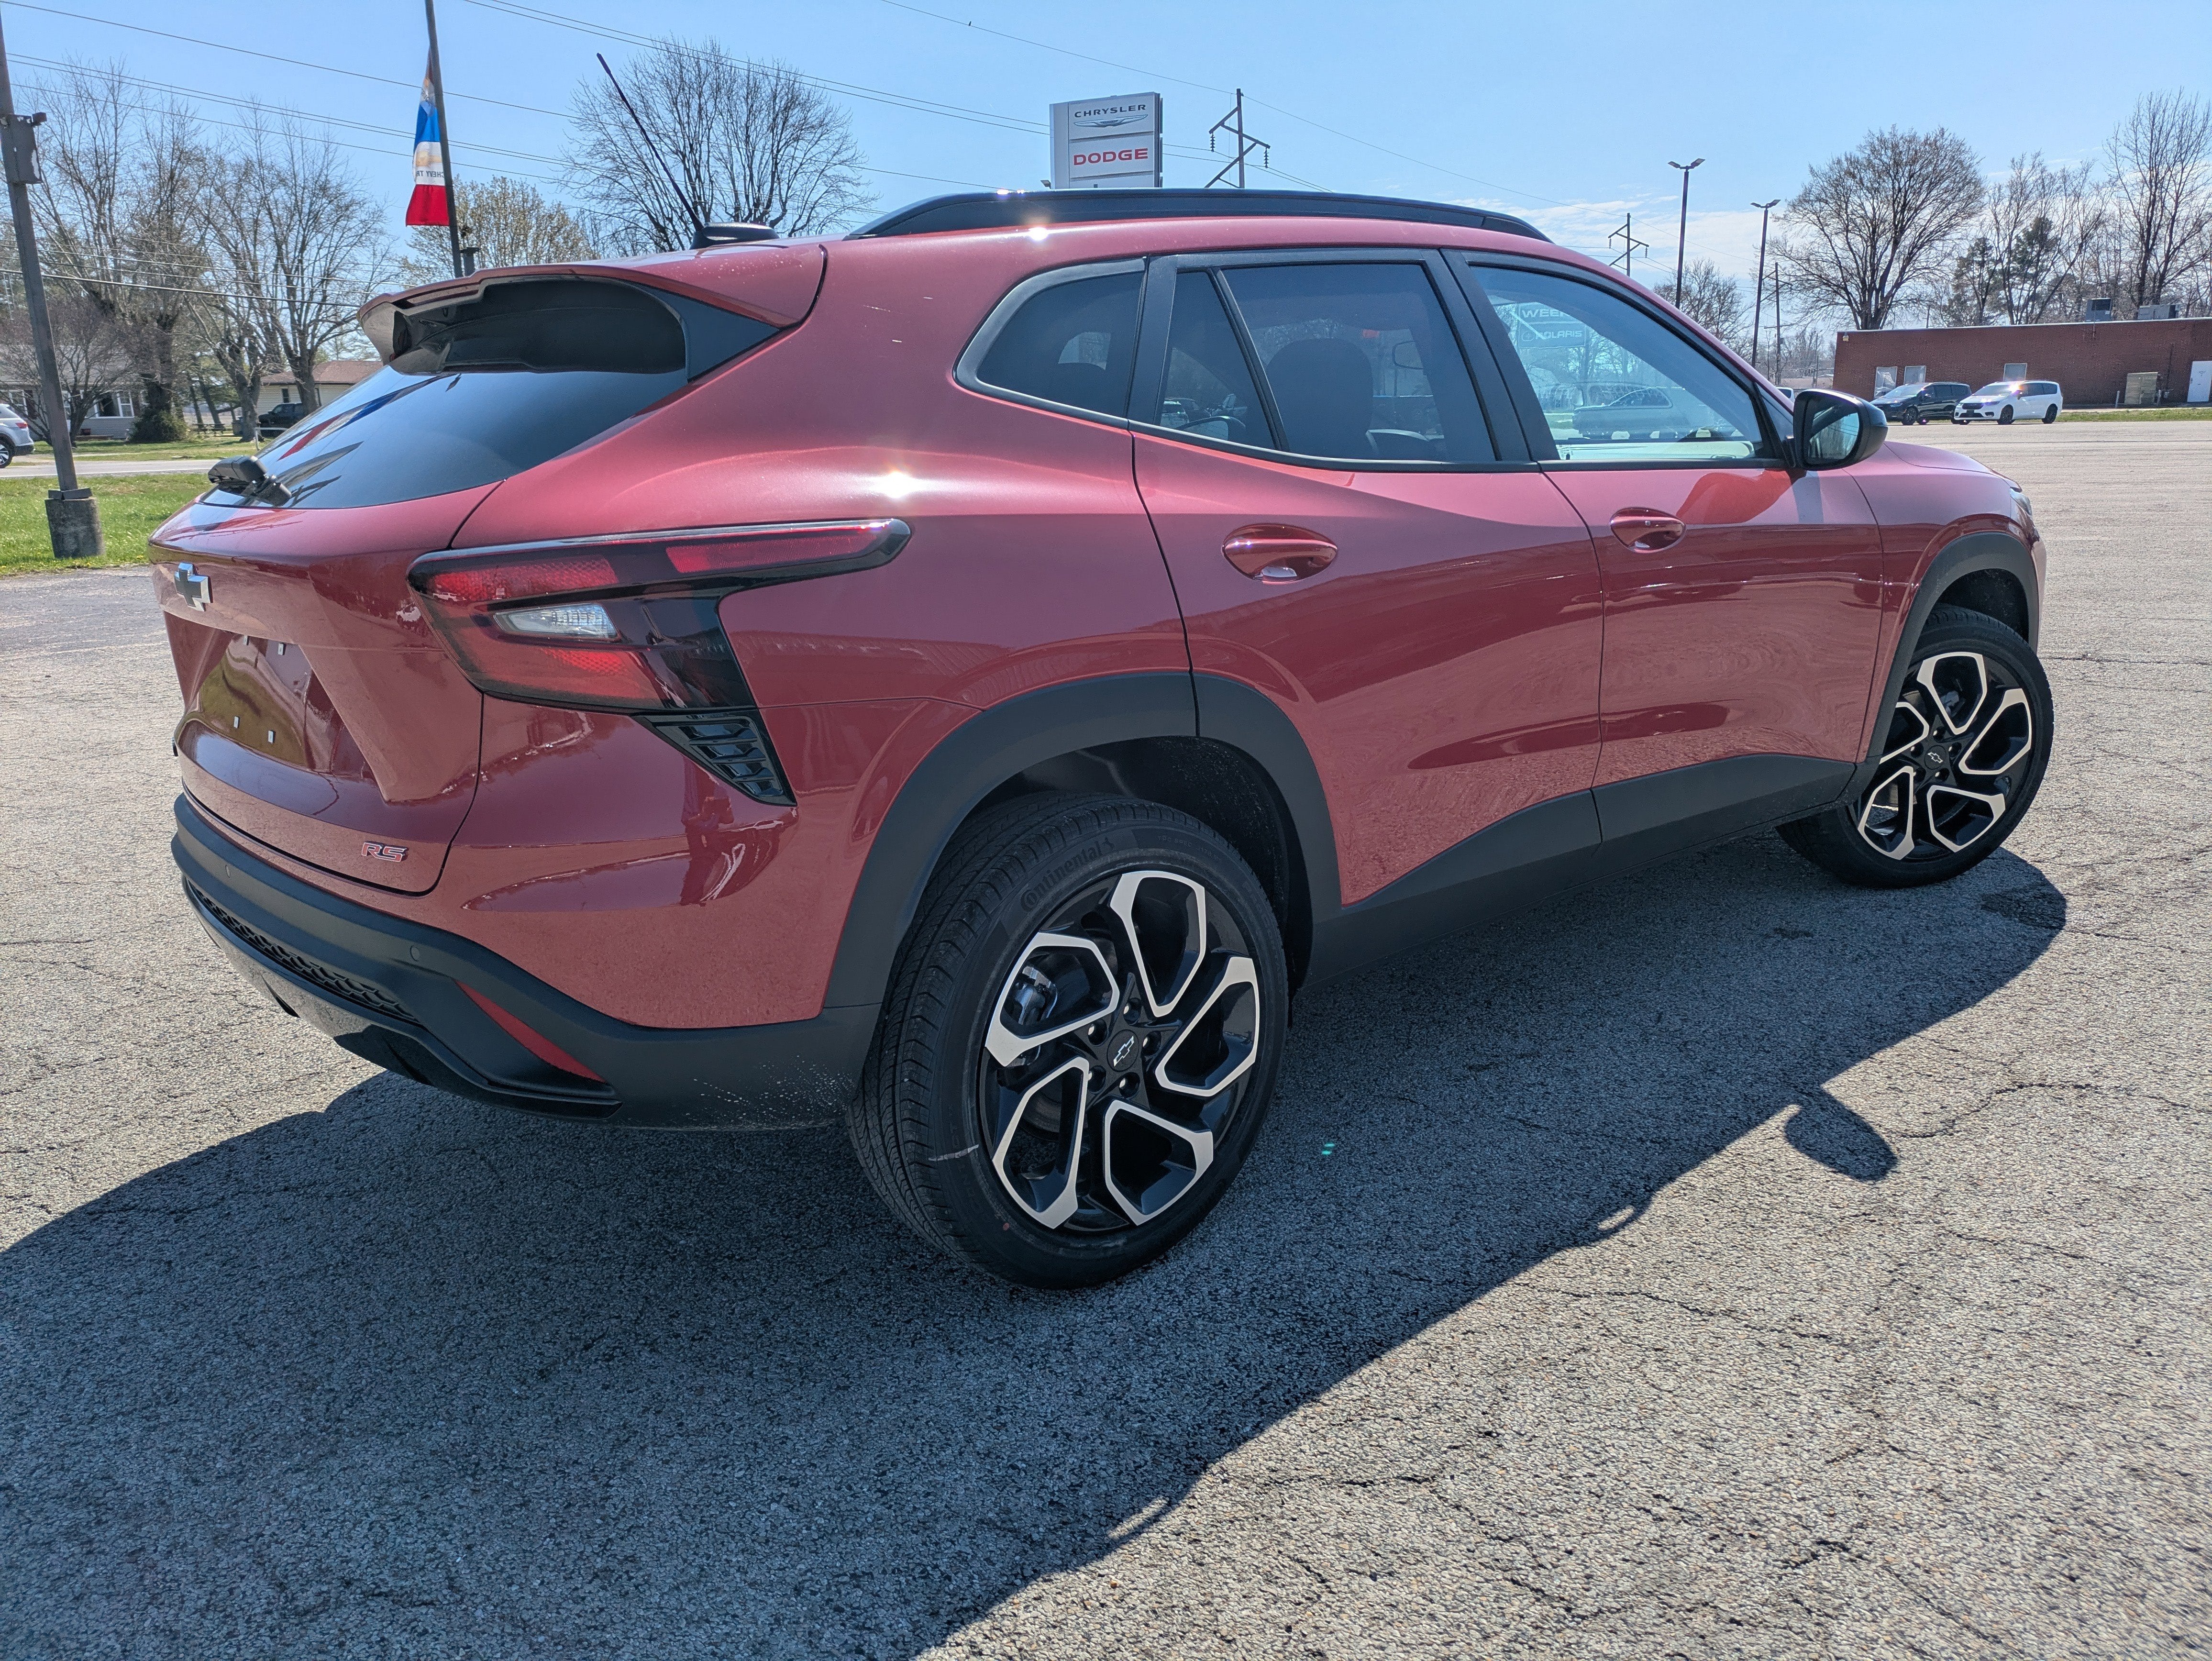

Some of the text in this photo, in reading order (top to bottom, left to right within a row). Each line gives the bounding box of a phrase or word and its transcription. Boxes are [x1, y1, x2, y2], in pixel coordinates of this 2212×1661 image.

[1074, 104, 1146, 118] CHRYSLER
[1073, 148, 1148, 166] DODGE
[362, 842, 407, 862] RS
[1020, 841, 1103, 911] Continental
